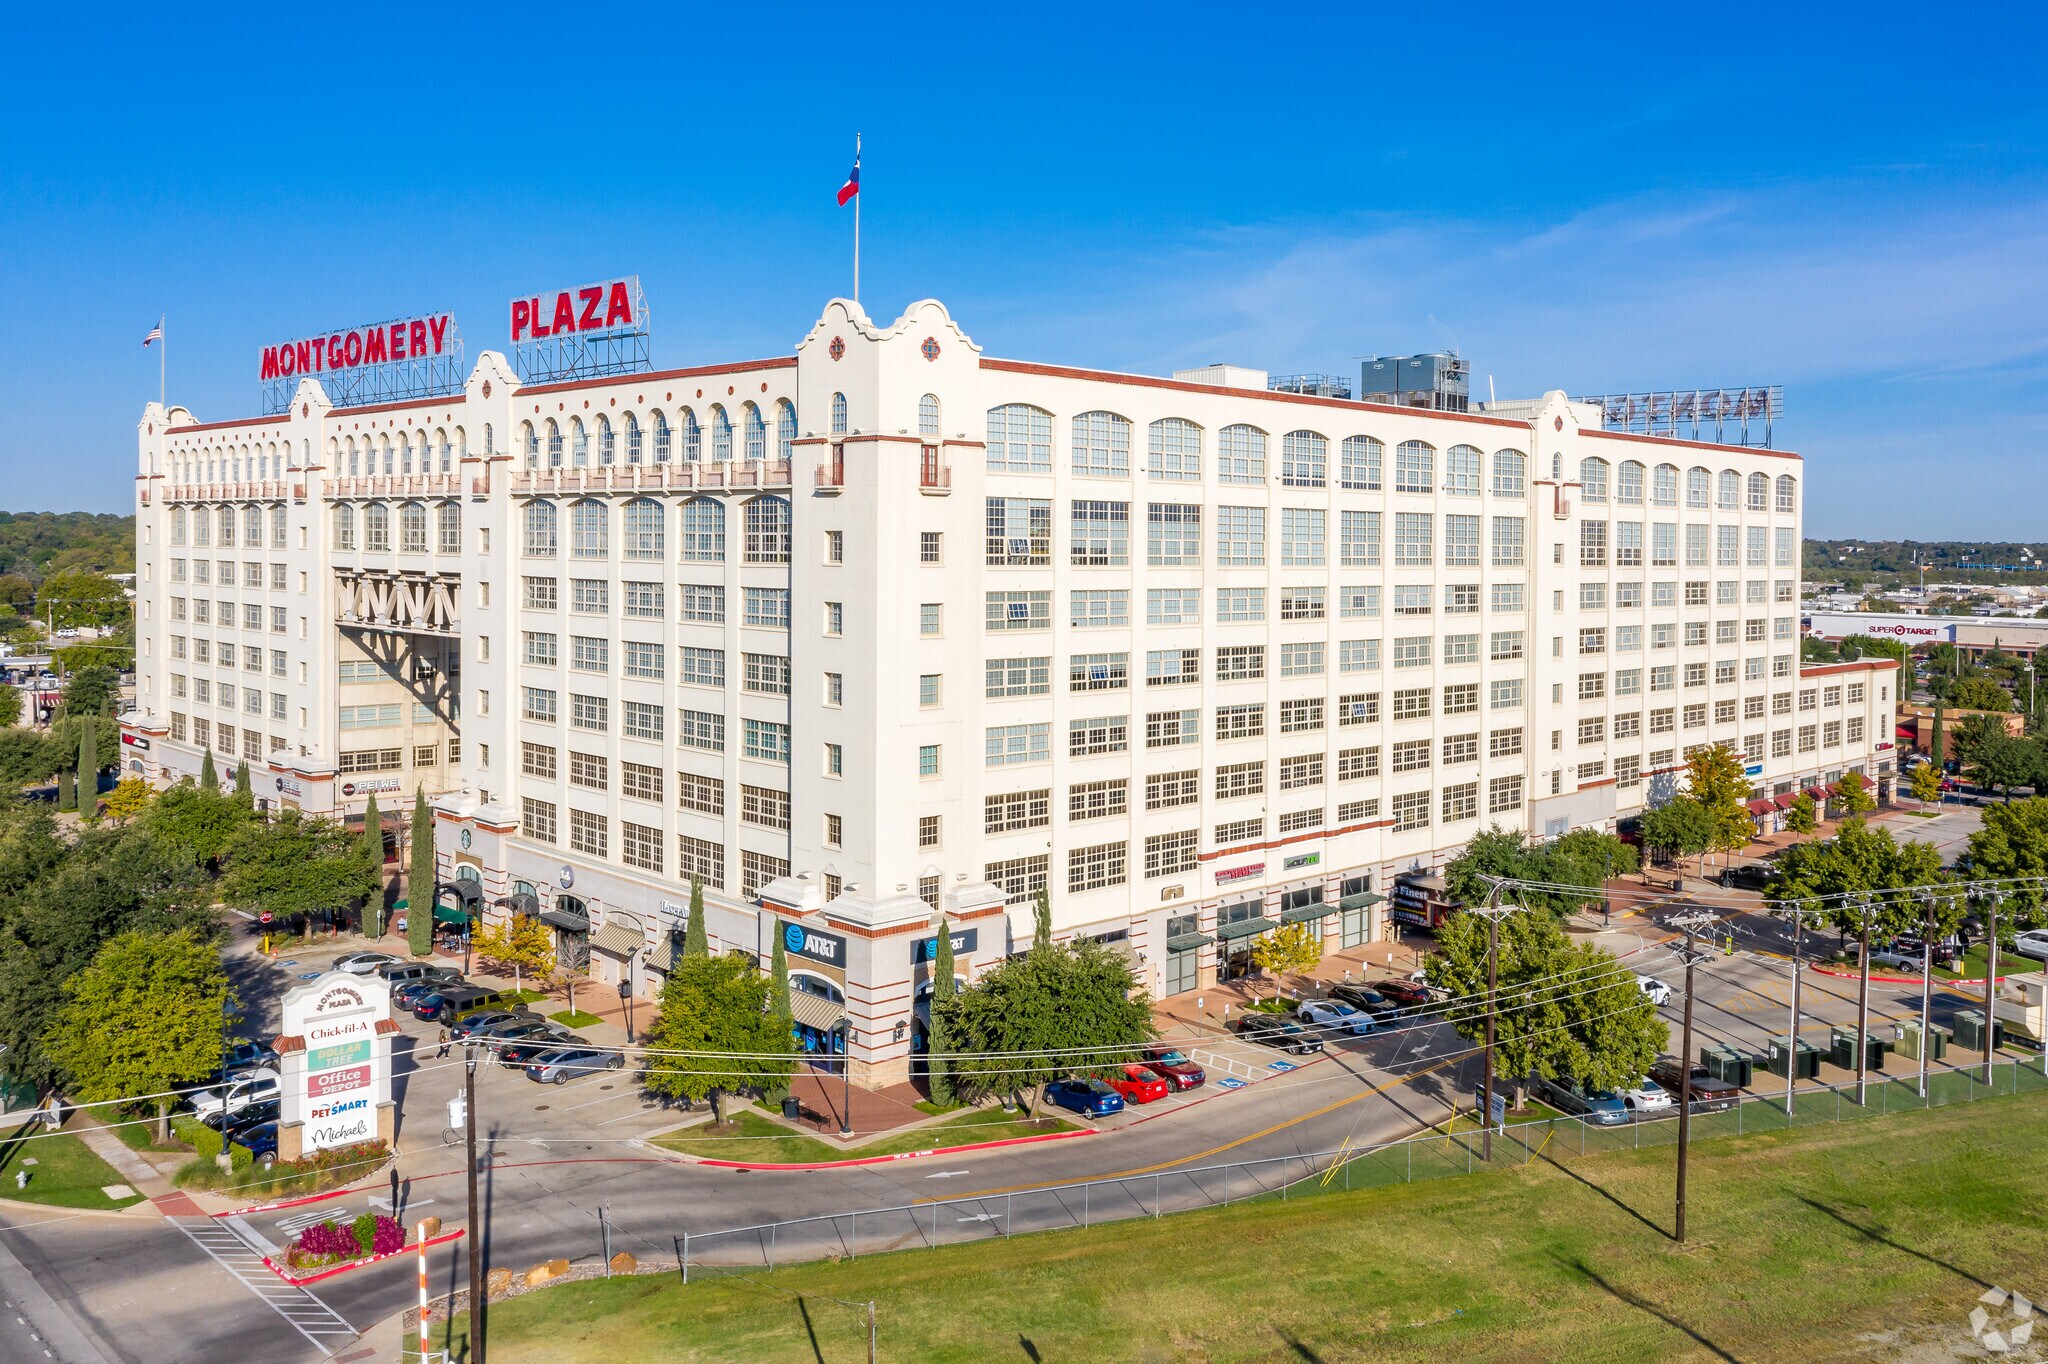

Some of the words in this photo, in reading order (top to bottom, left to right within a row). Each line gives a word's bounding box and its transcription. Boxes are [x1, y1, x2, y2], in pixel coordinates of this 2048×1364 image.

[261, 315, 448, 380] MONTGOMERY
[511, 281, 633, 341] PLAZA
[1868, 625, 1894, 633] SUPER
[1906, 627, 1938, 636] TARGET
[358, 781, 378, 791] PEI
[381, 778, 400, 788] WEI
[1399, 885, 1429, 900] Finest
[804, 934, 837, 958] AT&T
[328, 999, 352, 1009] PLAZA
[310, 1021, 368, 1040] Chick-fil-A
[317, 1043, 362, 1060] DOLLAR
[326, 1054, 354, 1067] TREE
[318, 1070, 361, 1086] Office
[321, 1080, 361, 1095] DEPOT
[311, 1119, 368, 1144] Michaels
